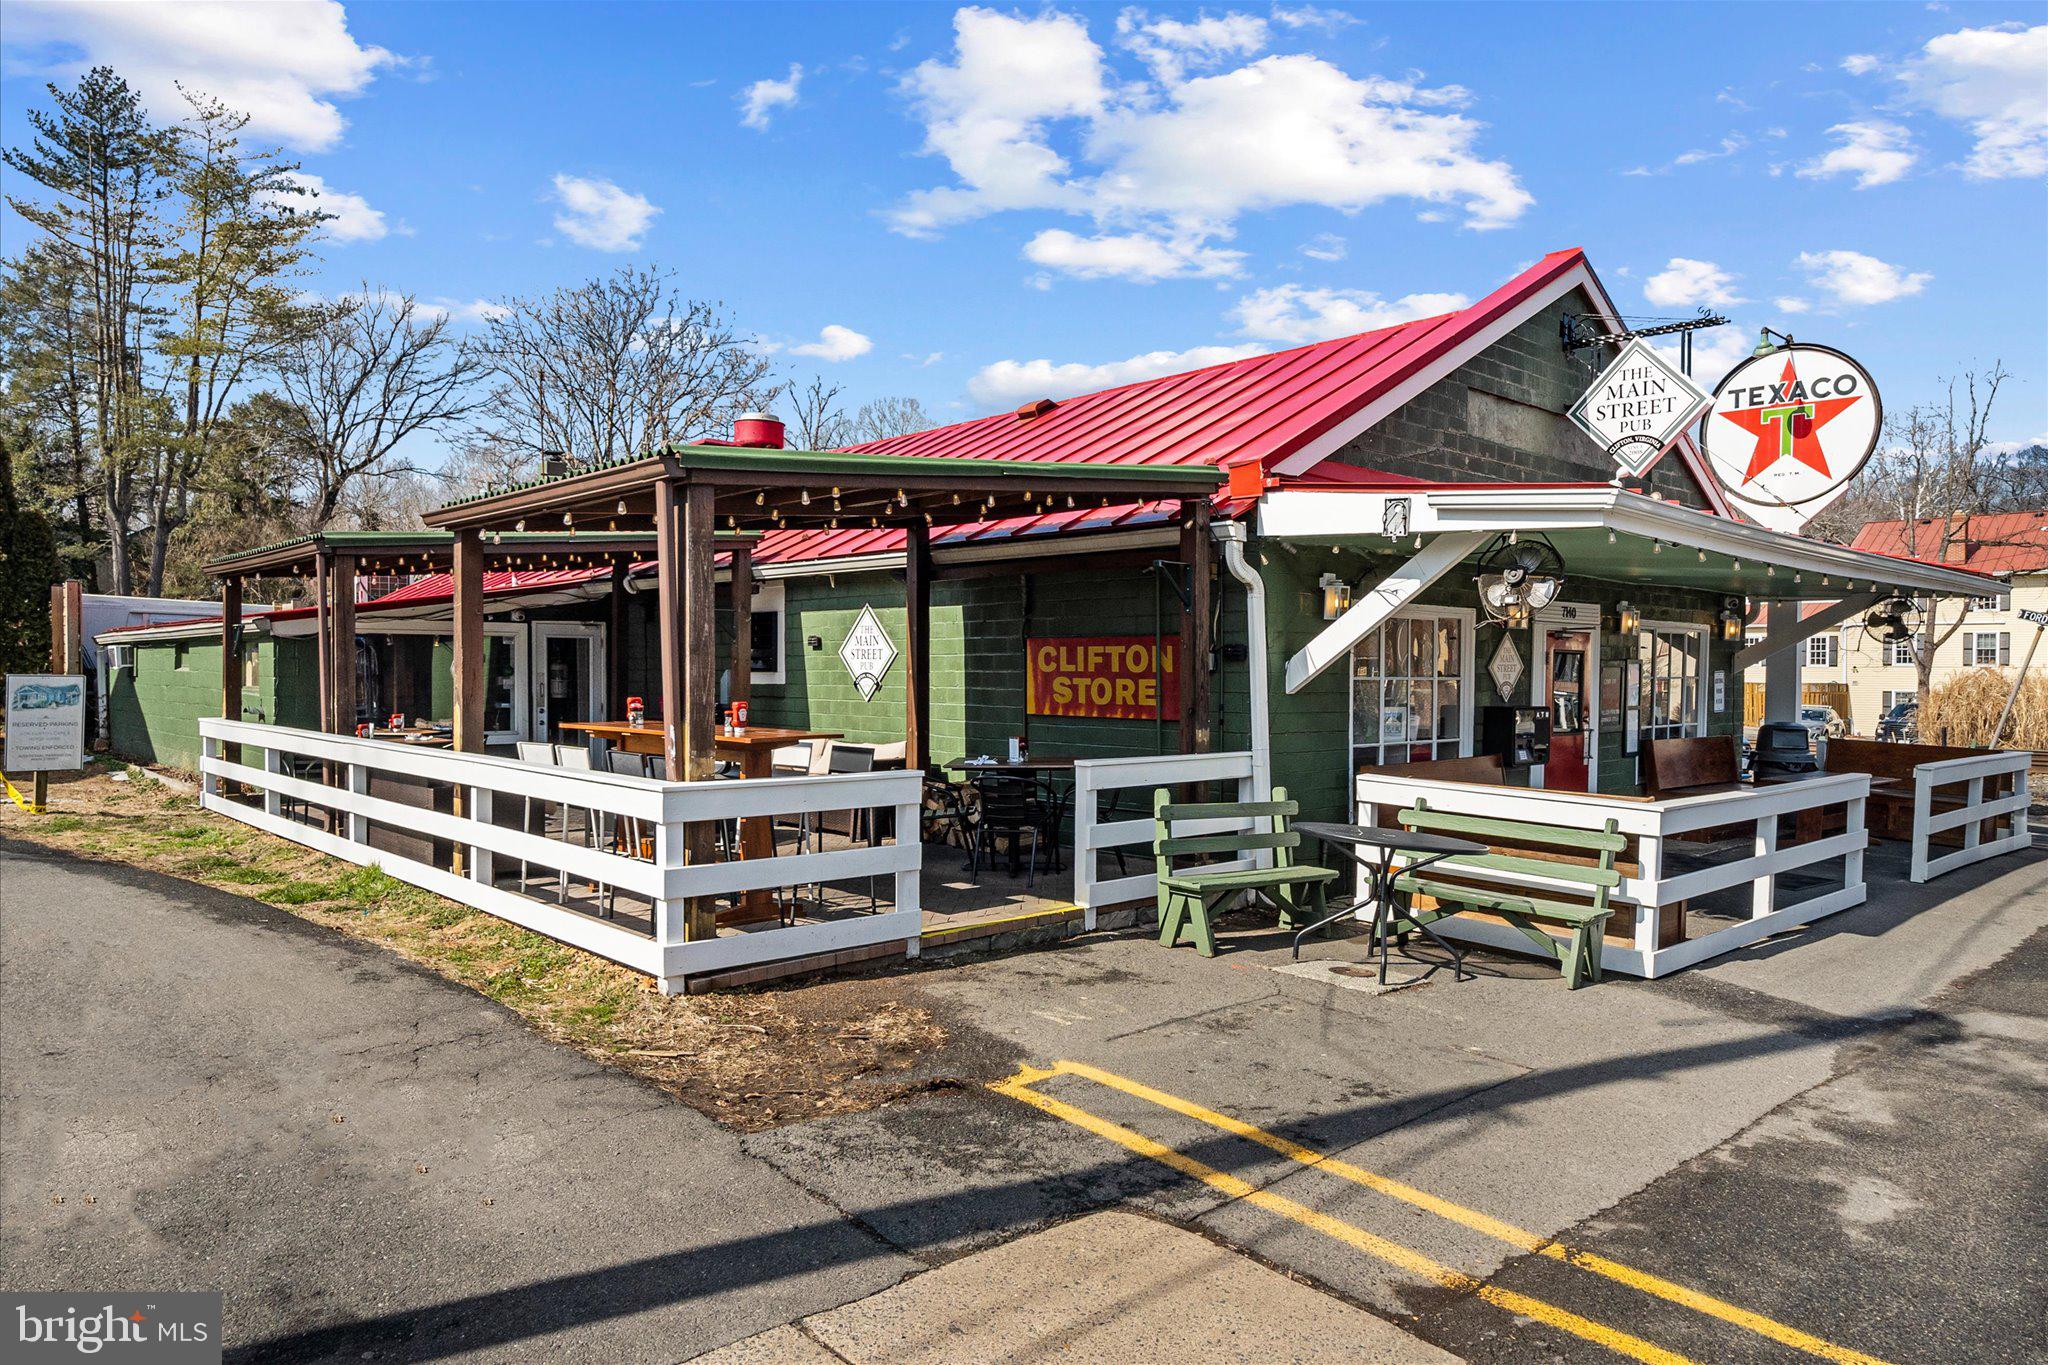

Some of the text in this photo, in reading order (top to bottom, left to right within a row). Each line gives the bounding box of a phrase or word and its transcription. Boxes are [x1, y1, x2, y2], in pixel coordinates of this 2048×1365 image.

[1619, 366, 1653, 381] THE
[1606, 378, 1666, 400] MAIN
[1728, 374, 1857, 409] TEXACO
[1596, 397, 1676, 421] STREET
[1620, 419, 1652, 433] PUB
[1634, 436, 1661, 449] VIRGINIA
[2023, 611, 2048, 625] FORD
[860, 625, 874, 634] THE
[854, 635, 880, 646] MAIN
[851, 648, 884, 660] STREET
[1037, 644, 1174, 673] CLIFTON
[860, 662, 874, 670] PUB
[1496, 664, 1517, 673] STREET
[1052, 676, 1158, 706] STORE
